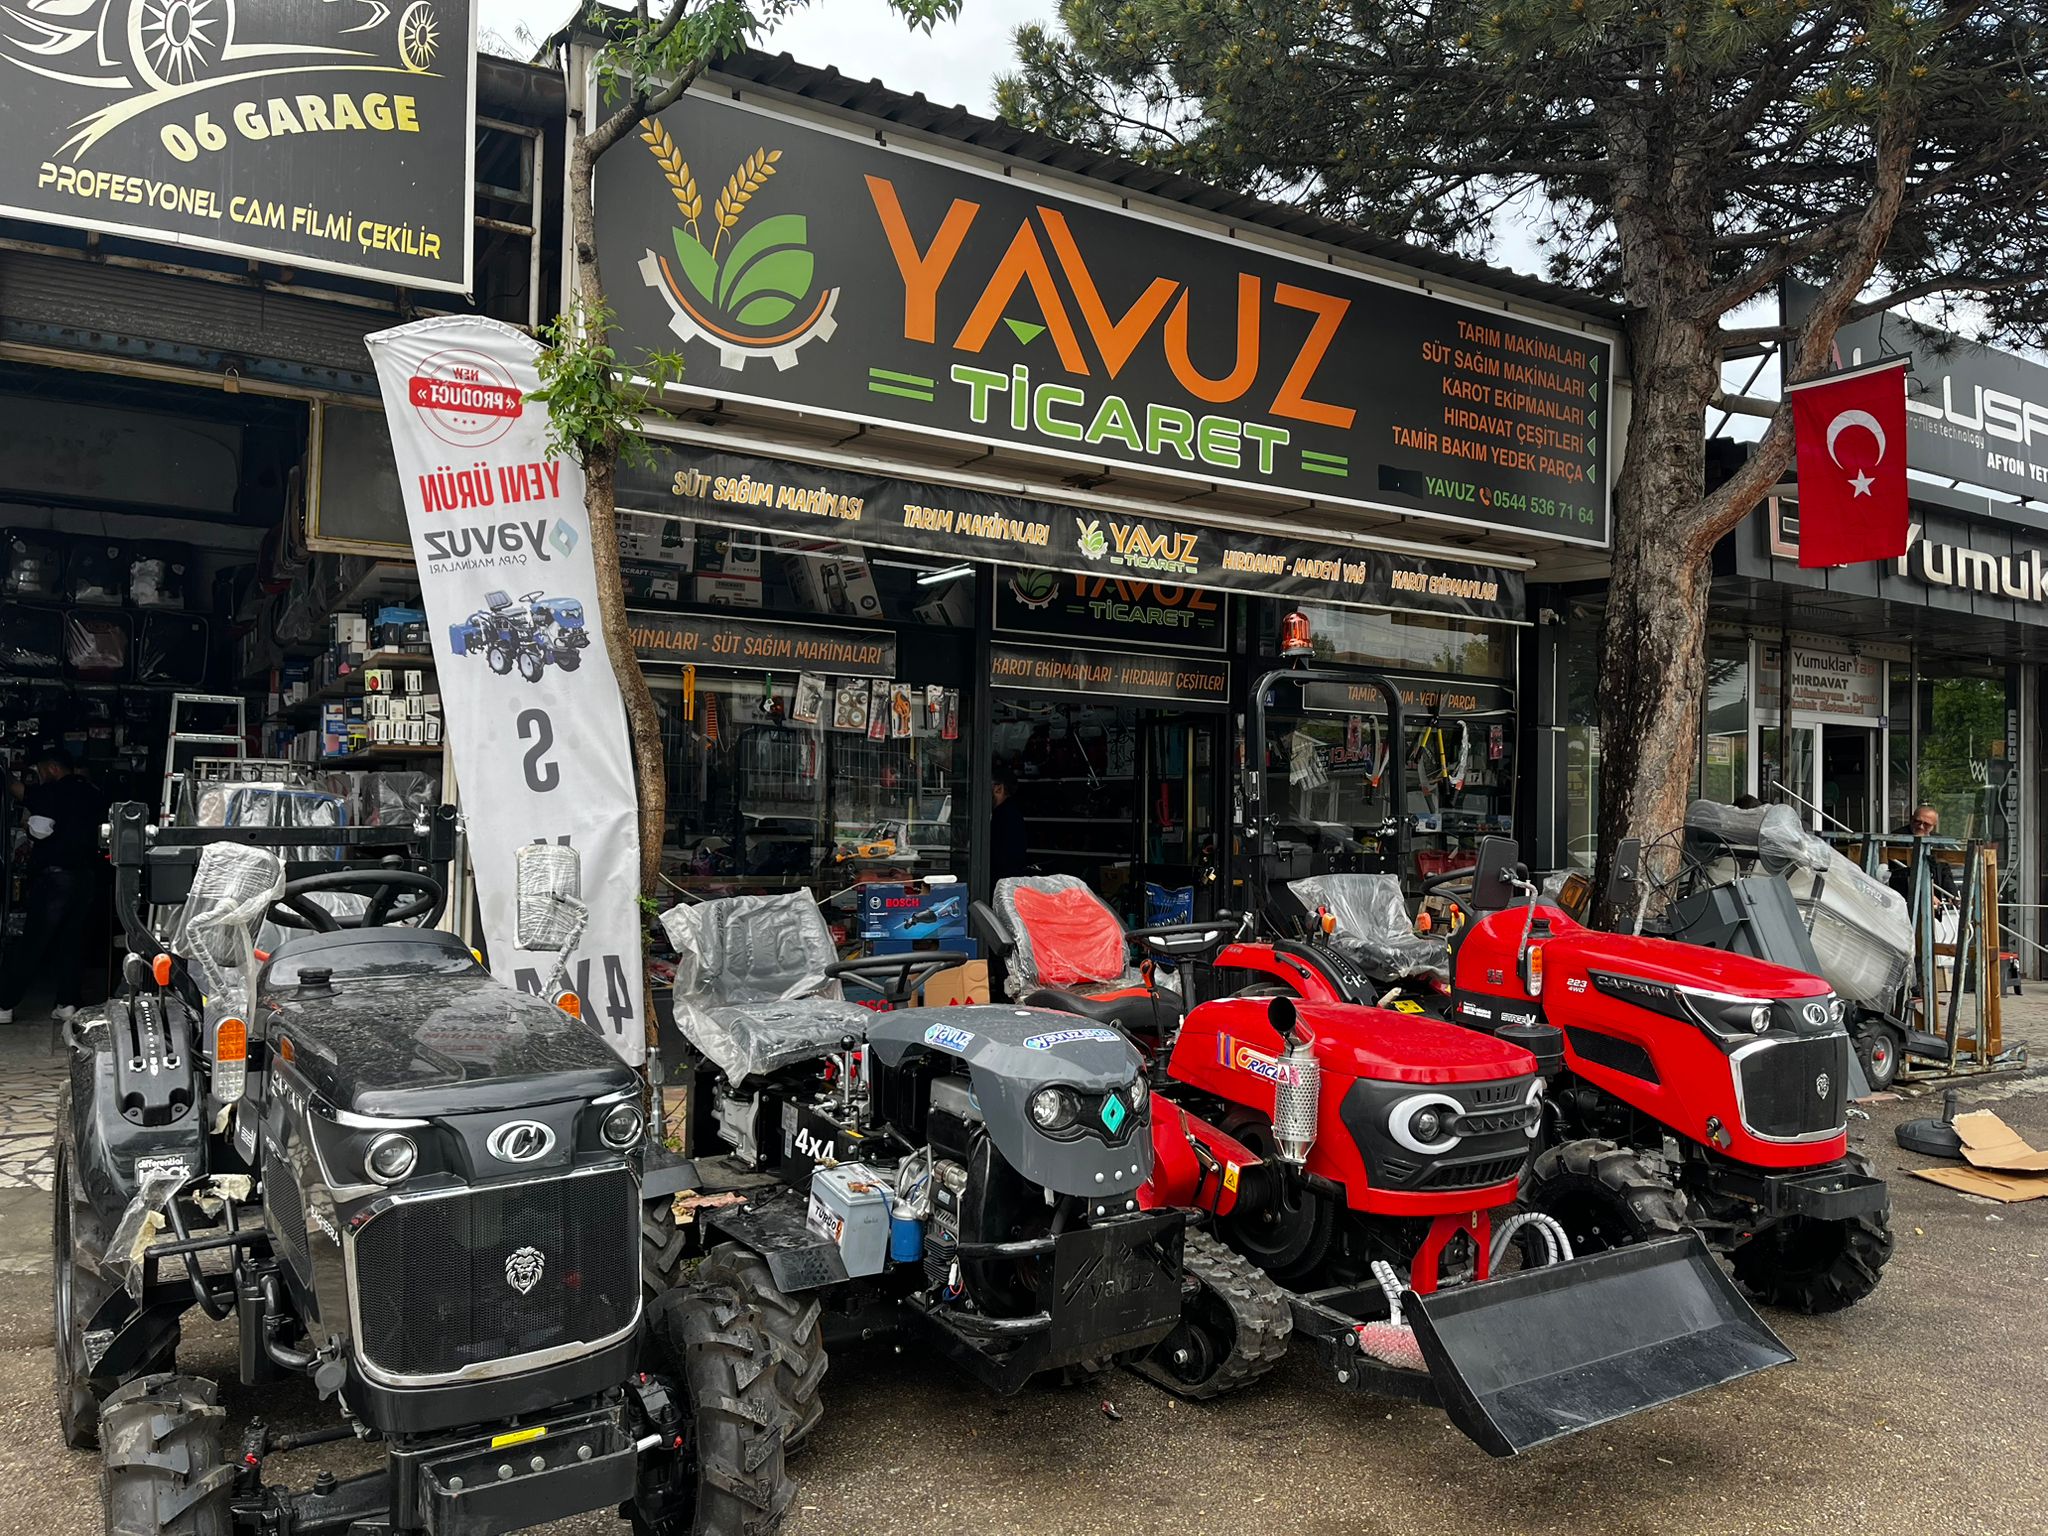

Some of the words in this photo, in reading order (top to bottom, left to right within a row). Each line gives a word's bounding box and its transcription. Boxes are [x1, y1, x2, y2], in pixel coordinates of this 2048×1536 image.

[160, 111, 228, 163] 06
[233, 92, 420, 141] GARAGE
[38, 161, 223, 220] PROFESYONEL
[229, 195, 286, 230] CAM
[292, 202, 352, 240] FİLMİ
[357, 220, 442, 260] ÇEKİLİR
[864, 174, 1357, 430] YAVUZ
[1457, 320, 1501, 348] TARIM
[1504, 333, 1585, 369] MAKİNALARI
[1422, 341, 1450, 365] SÜT
[1453, 349, 1500, 378] SAĞIM
[1503, 361, 1585, 397] MAKİNALARI
[1442, 377, 1490, 405] KAROT
[1494, 388, 1584, 425] EKİPMANLARI
[950, 363, 1290, 475] TİCARET
[1444, 407, 1512, 438] HIRDAVAT
[1516, 422, 1584, 454] ÇEŞİTLERİ
[1907, 415, 1938, 434] rofiles
[1939, 422, 1984, 450] technology
[1392, 425, 1438, 453] TAMİR
[1442, 435, 1488, 463] BAKIM
[1491, 445, 1536, 472] YEDEK
[1540, 457, 1584, 484] PARÇA
[1987, 452, 2024, 478] AFYON
[672, 468, 711, 498] SÜT
[713, 475, 773, 508] SAĞIM
[776, 486, 864, 521] MAKİNASI
[1425, 475, 1475, 503] YAVUZ
[1494, 490, 1527, 514] 0544
[1530, 497, 1555, 518] 536
[1559, 503, 1575, 521] 71
[1577, 505, 1594, 525] 64
[903, 504, 951, 533] TARIM
[954, 511, 1050, 546] MAKİNALARI
[1109, 521, 1199, 564] YAVUZ
[1123, 554, 1186, 574] TİCARET
[1222, 550, 1286, 576] HIRDAVAT
[1391, 570, 1428, 592] KAROT
[1089, 599, 1194, 628] TİCARET
[712, 634, 741, 653] SÜT
[744, 635, 791, 658] SAĞIM
[795, 640, 881, 664] MAKİNALARI
[992, 657, 1033, 675] KAROT
[1035, 659, 1112, 683] EKİPMANLARI
[1121, 668, 1175, 689] HIRDAVAT
[1176, 671, 1225, 692] ÇEŞİTLERİ
[1793, 674, 1848, 690] HIRDAVAT
[1348, 684, 1377, 702] TAMİR
[886, 898, 919, 907] BOSCH
[1567, 978, 1587, 988] 223
[138, 1156, 183, 1168] differential
[815, 1205, 836, 1231] TURBO
